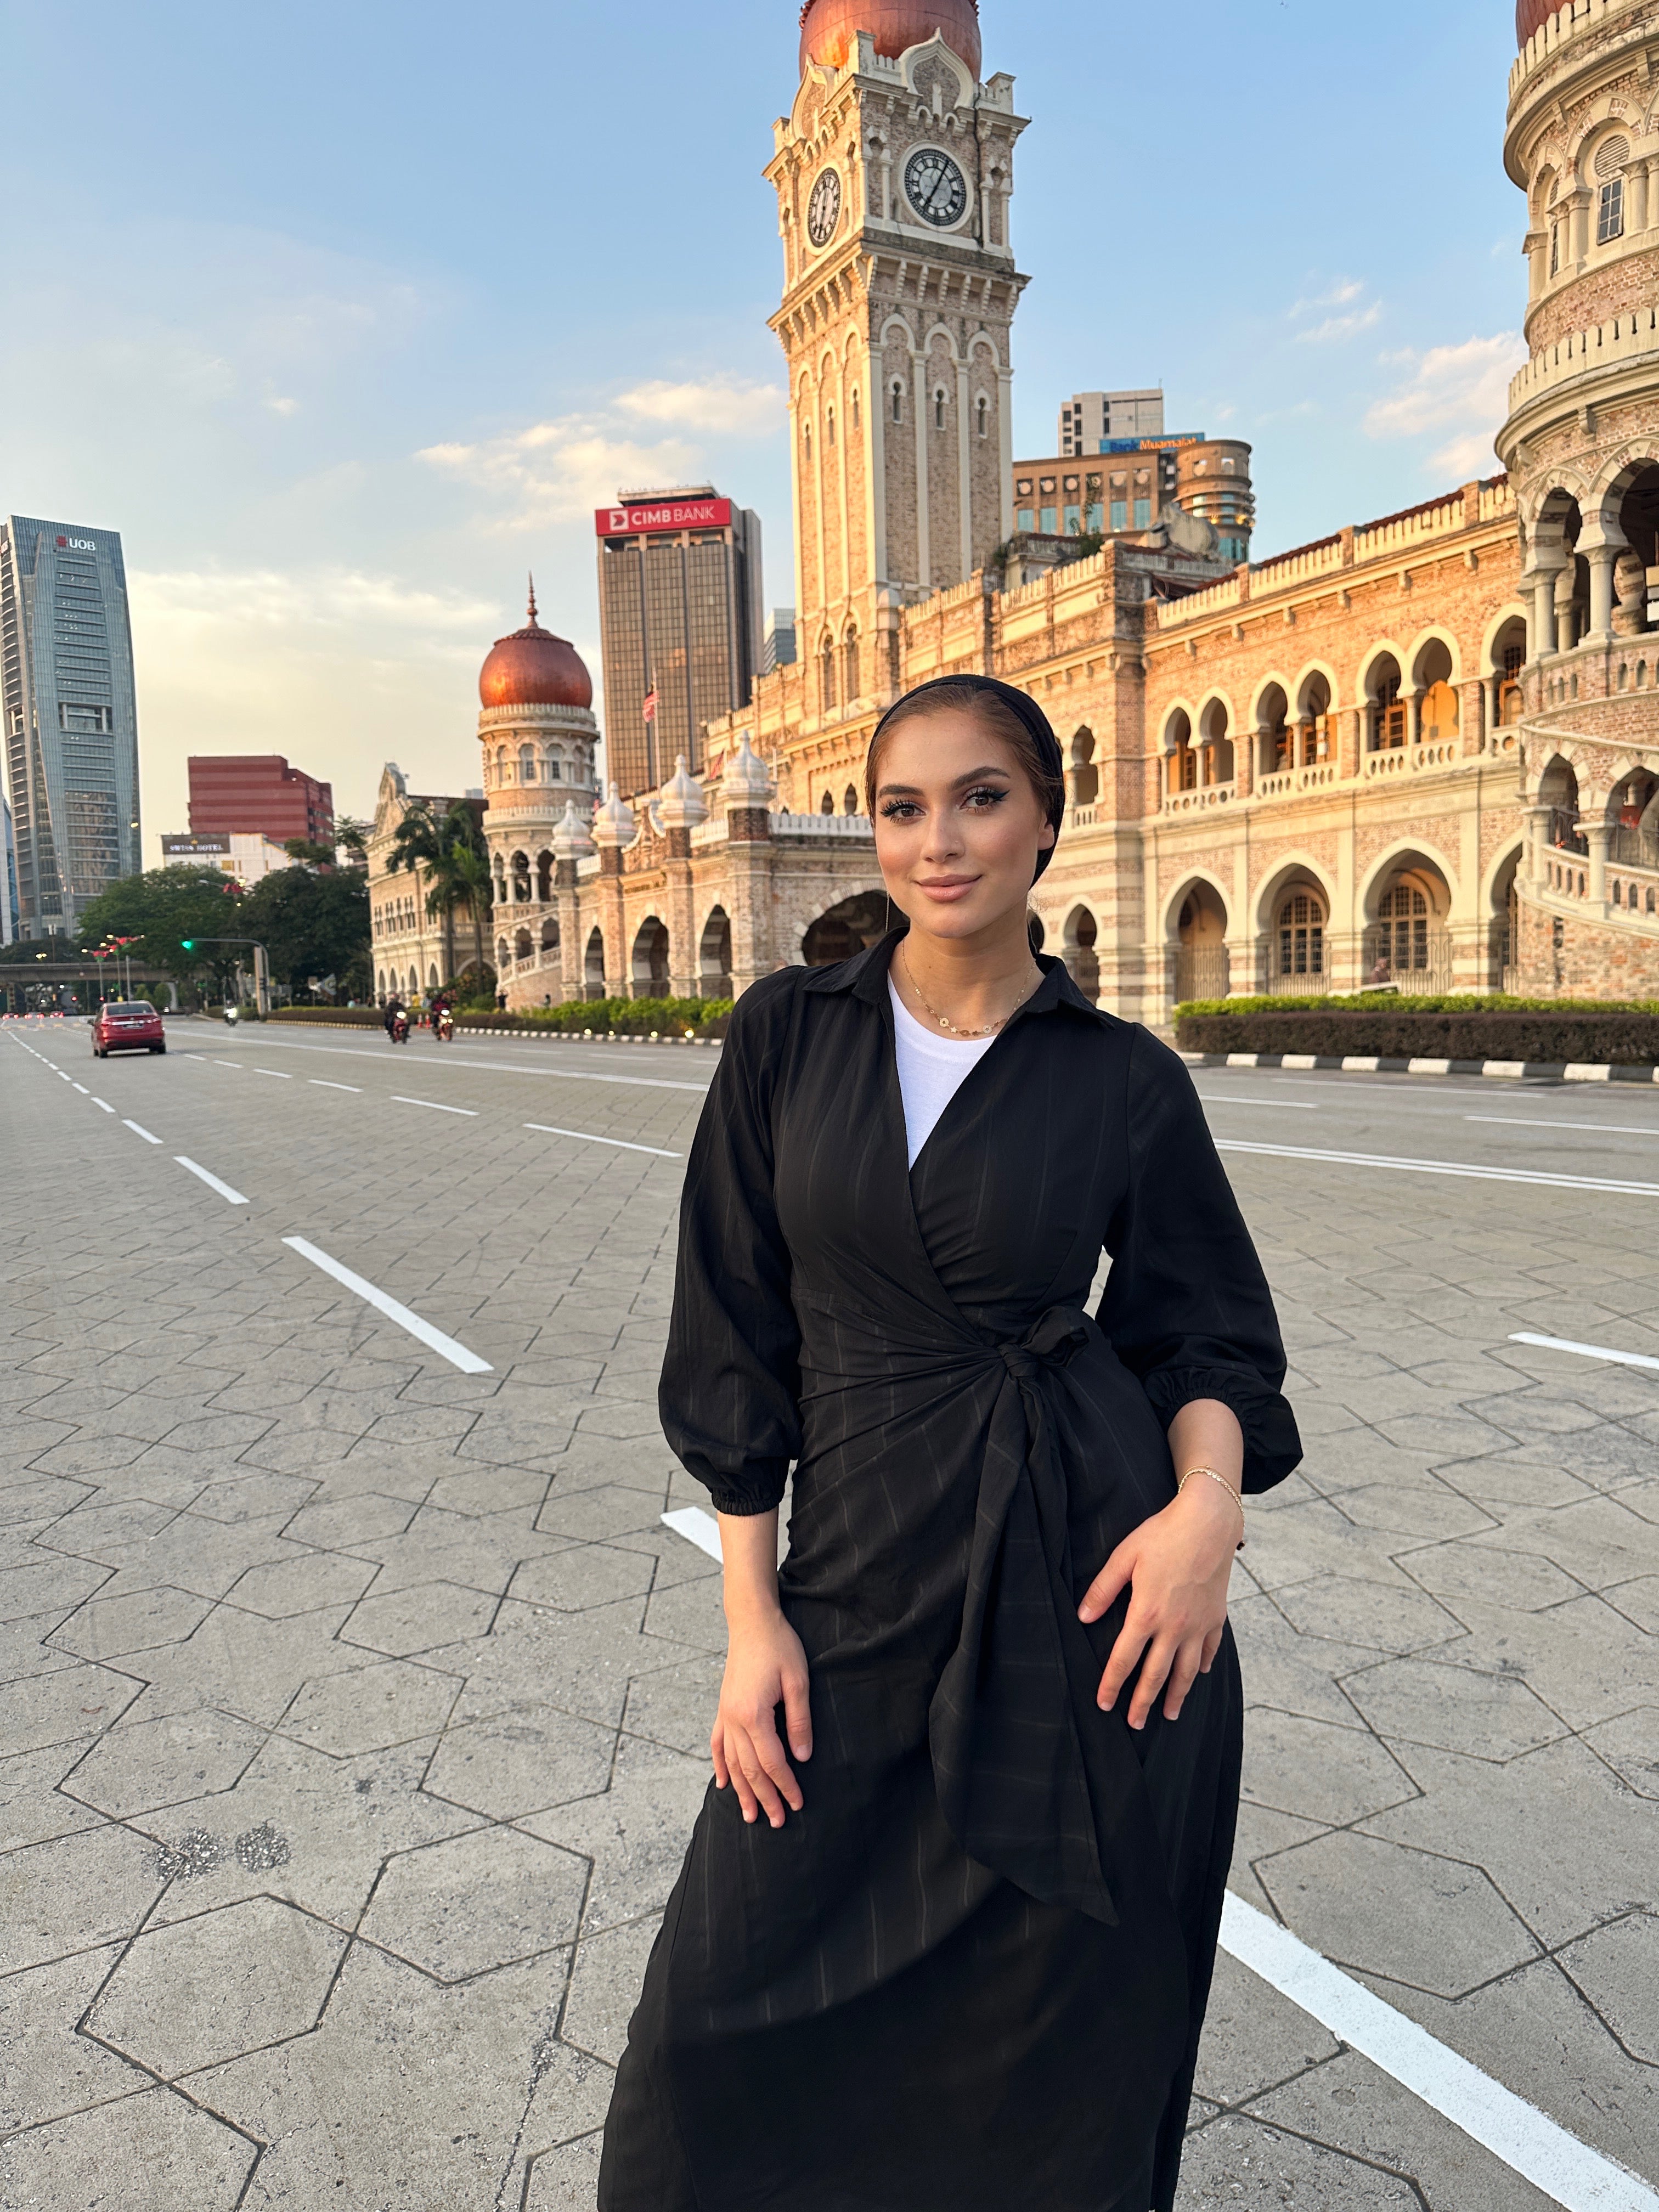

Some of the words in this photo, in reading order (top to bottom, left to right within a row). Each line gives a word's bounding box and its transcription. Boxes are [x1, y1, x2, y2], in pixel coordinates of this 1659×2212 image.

[1110, 439, 1138, 453] Bank
[631, 509, 672, 525] CIMB
[674, 506, 715, 522] BANK
[69, 538, 95, 551] UOB
